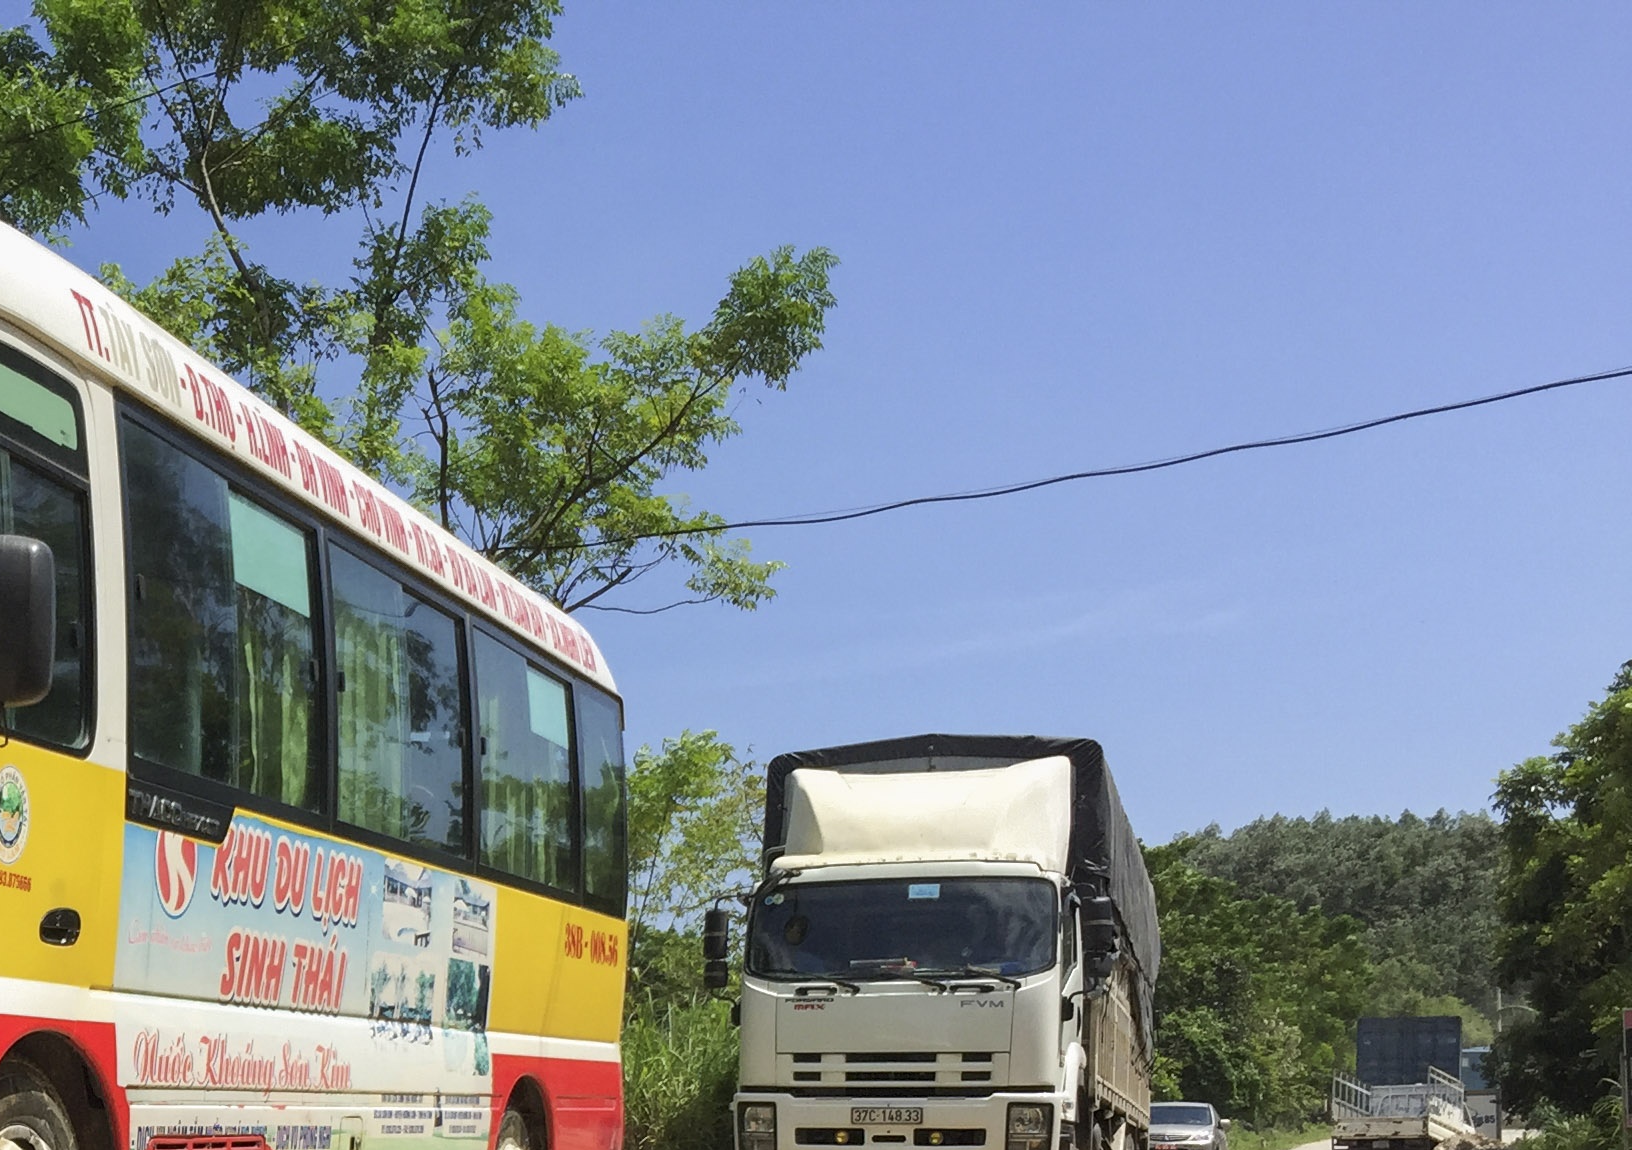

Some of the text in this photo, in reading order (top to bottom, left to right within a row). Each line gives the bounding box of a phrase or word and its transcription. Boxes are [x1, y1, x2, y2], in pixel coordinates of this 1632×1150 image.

[212, 824, 271, 906] KHU
[274, 836, 310, 915] DU
[311, 847, 363, 936] LỊCH
[220, 926, 287, 1007] SINH
[290, 930, 347, 1014] THÁI
